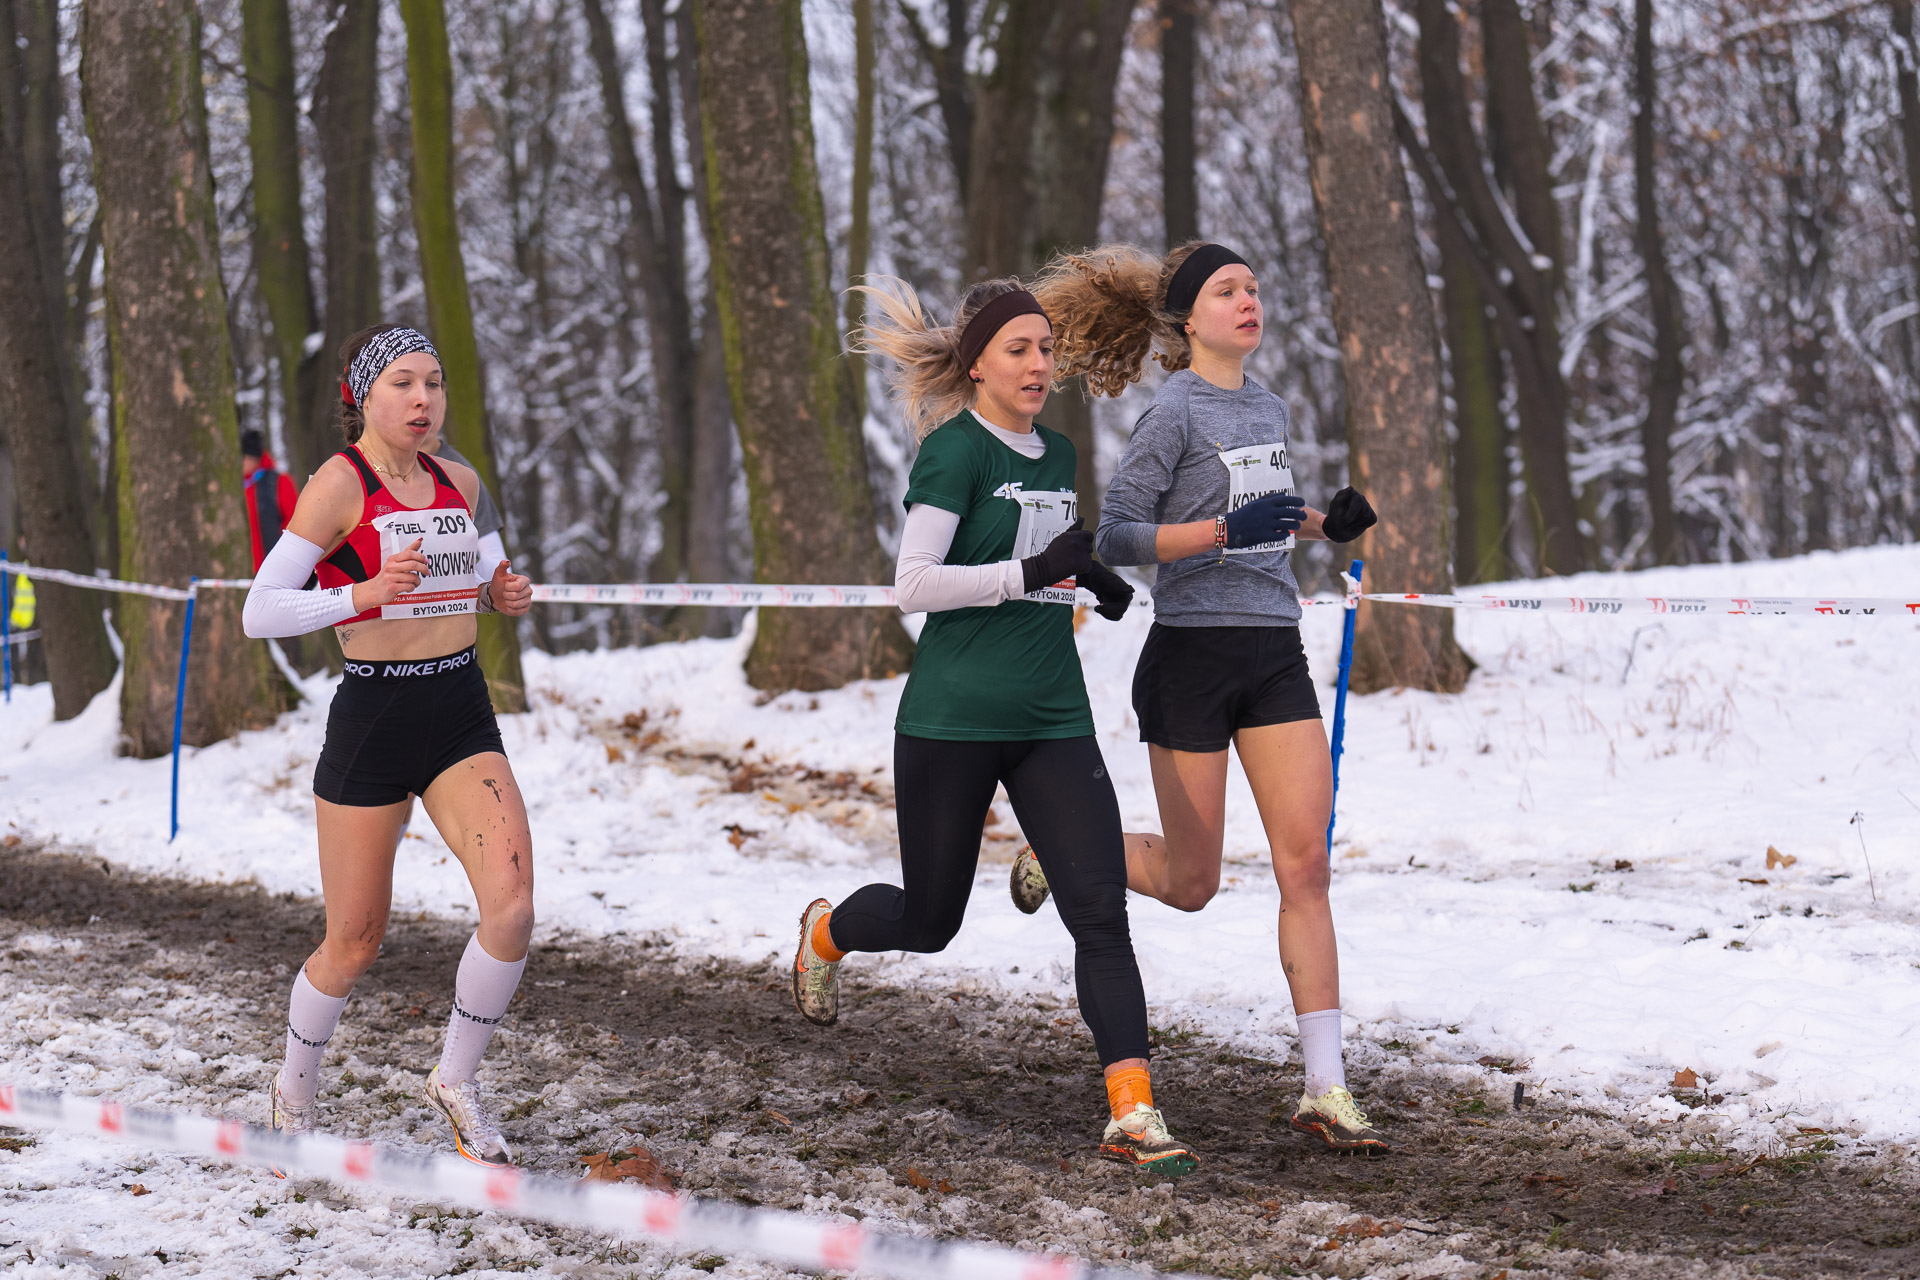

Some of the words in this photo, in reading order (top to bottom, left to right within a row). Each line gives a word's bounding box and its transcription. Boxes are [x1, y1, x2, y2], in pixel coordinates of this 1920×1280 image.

[394, 523, 426, 535] FUEL
[433, 515, 466, 535] 209
[1030, 590, 1060, 601] BYTOM
[412, 604, 447, 616] BYTOM
[447, 602, 468, 613] 2024
[383, 662, 437, 678] NIKE
[437, 652, 470, 673] PRO
